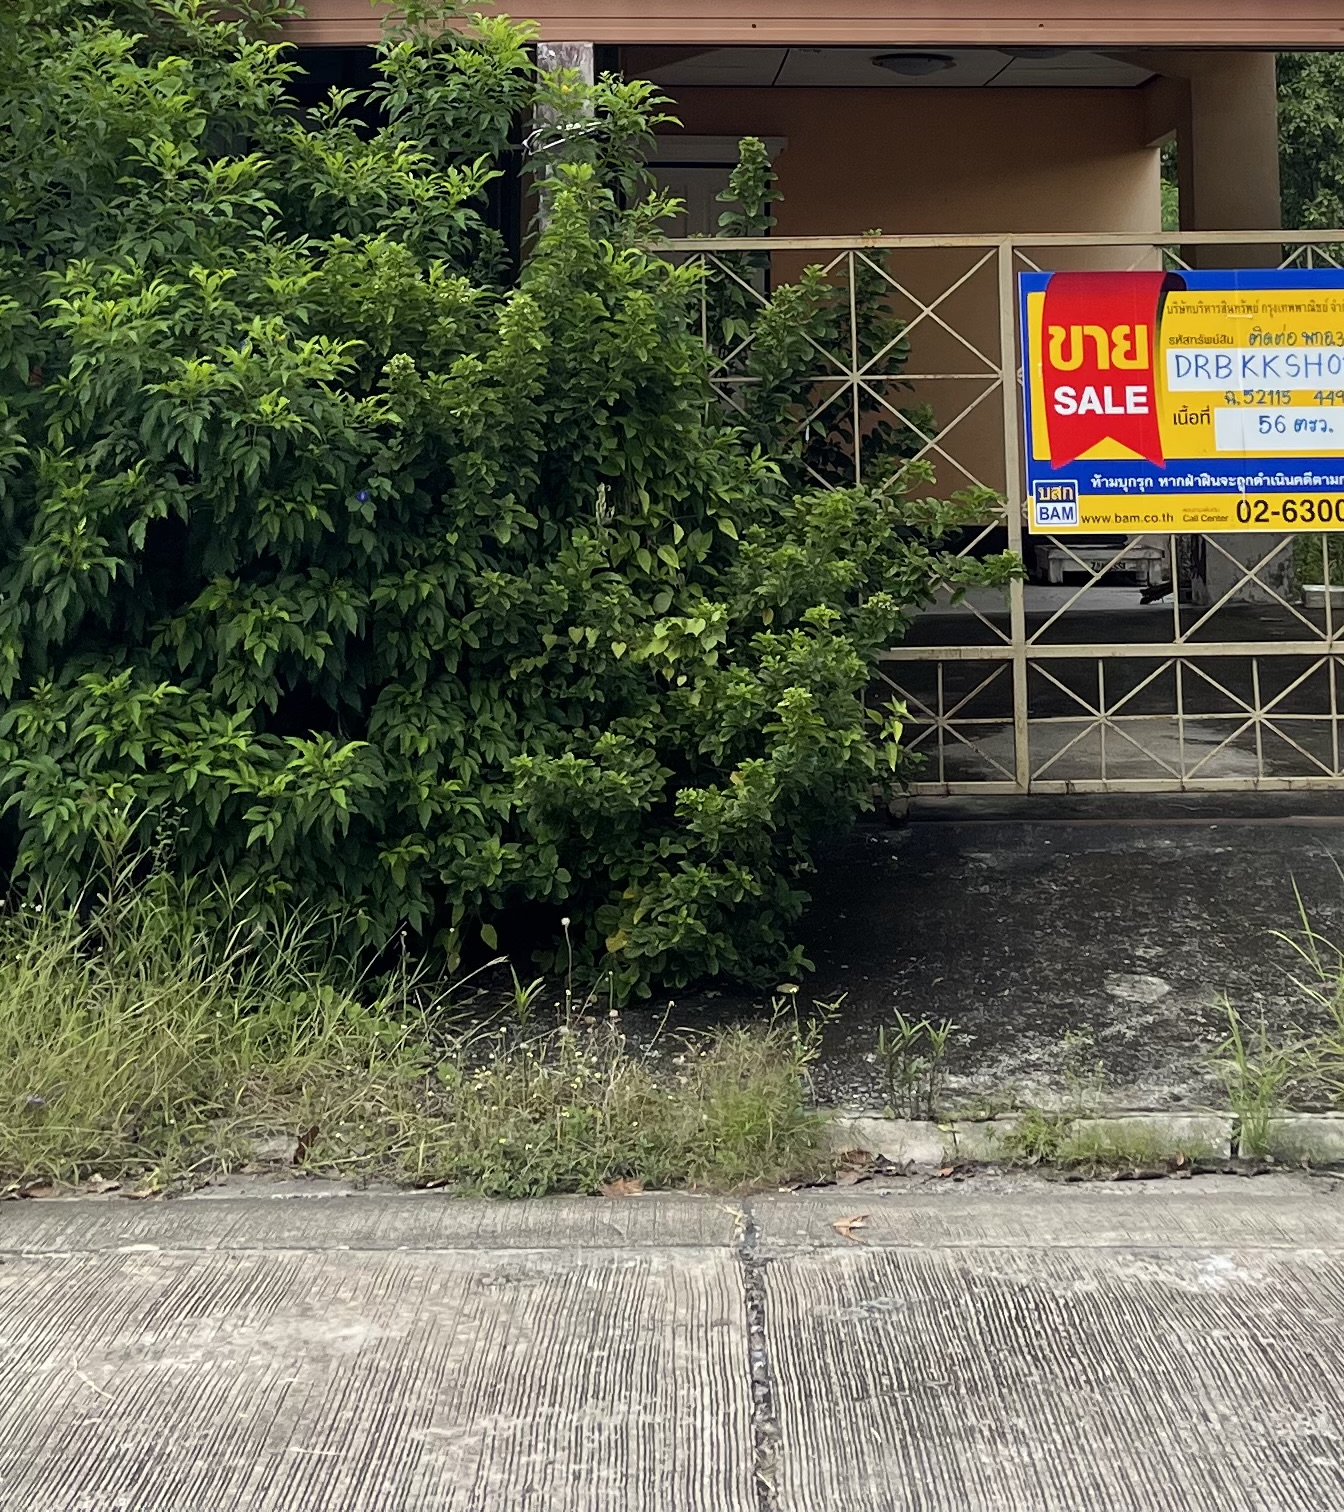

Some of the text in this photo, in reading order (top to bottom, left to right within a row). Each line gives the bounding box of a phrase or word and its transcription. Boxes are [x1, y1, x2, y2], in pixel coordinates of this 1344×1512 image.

[1167, 299, 1260, 315] บริษัทบริหารสินทรัพย์
[1261, 298, 1329, 317] กรุงเทพพาณิชย์
[1168, 332, 1234, 345] รหัสทรัพย์สิน
[1248, 324, 1297, 347] ติดต่อ
[1048, 323, 1149, 372] ขาย
[1053, 385, 1149, 416] SALE
[1173, 404, 1211, 426] เนื้อที่
[1258, 414, 1286, 434] 56
[1090, 472, 1153, 492] ห้ามบุกรุก
[1037, 486, 1074, 501] บสก
[1039, 505, 1074, 521] BAM
[1080, 512, 1174, 524] www.bam.co.th
[1182, 513, 1229, 522] Call Center
